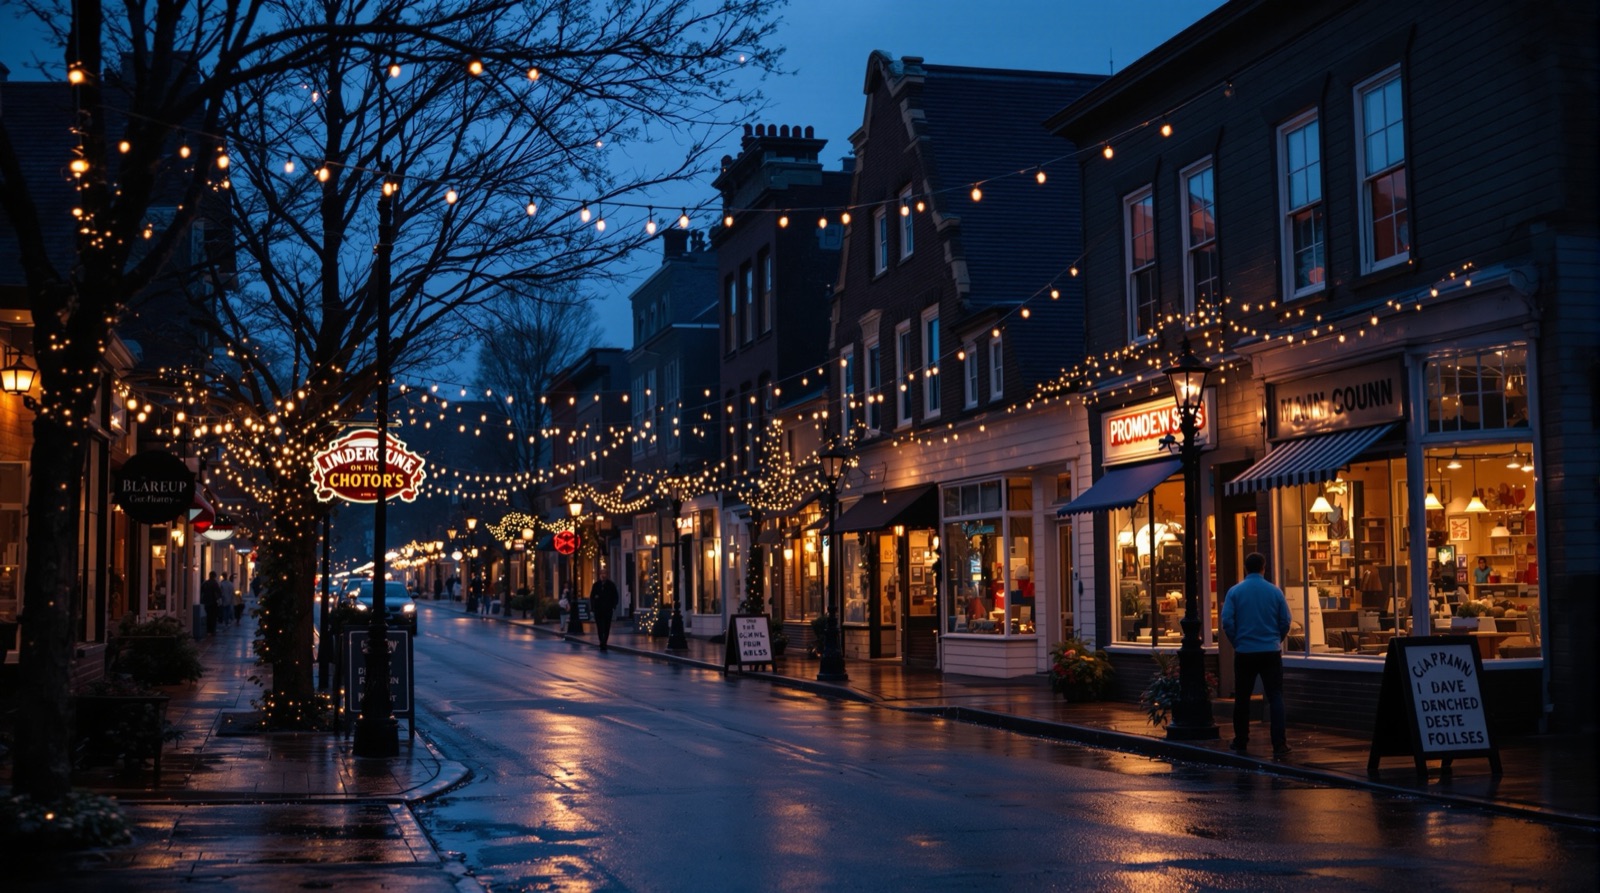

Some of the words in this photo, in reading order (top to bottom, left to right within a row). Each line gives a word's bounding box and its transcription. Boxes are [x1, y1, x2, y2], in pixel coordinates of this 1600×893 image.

[1332, 378, 1393, 415] COUNN
[122, 479, 188, 493] BLAREUP
[329, 472, 405, 488] CHOTOR'S
[1431, 680, 1466, 694] DAVE
[1425, 714, 1464, 728] DESTE
[1428, 731, 1485, 746] FOLLSES
